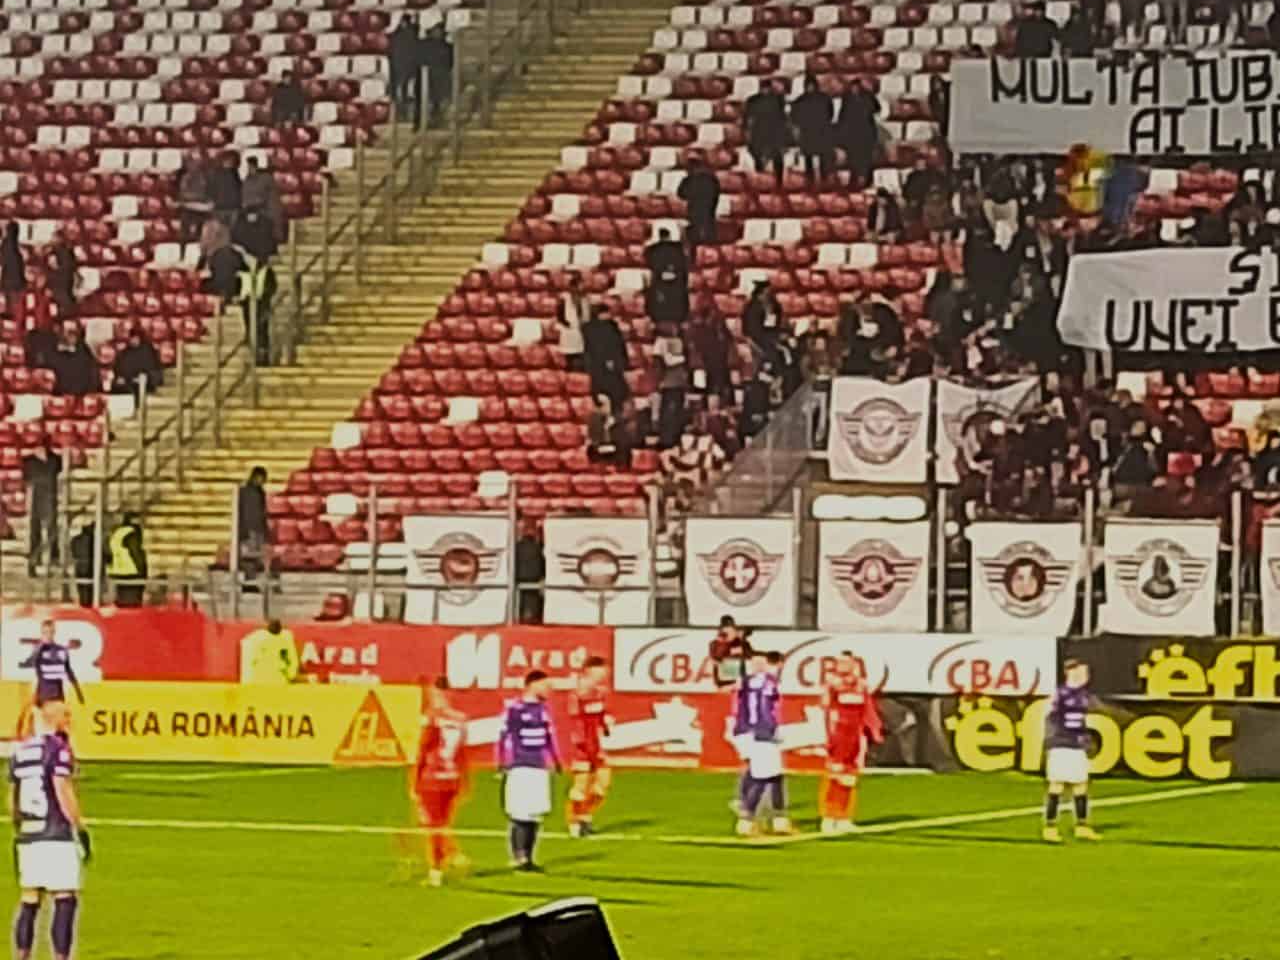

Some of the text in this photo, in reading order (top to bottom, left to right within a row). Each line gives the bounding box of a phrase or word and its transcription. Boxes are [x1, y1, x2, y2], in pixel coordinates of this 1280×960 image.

[991, 50, 1160, 105] MULTA
[1129, 106, 1186, 153] AI
[1106, 298, 1239, 351] UNEI
[301, 642, 378, 665] Arad
[508, 644, 587, 668] Arad
[947, 659, 1019, 690] CBA
[93, 709, 160, 736] SIKA
